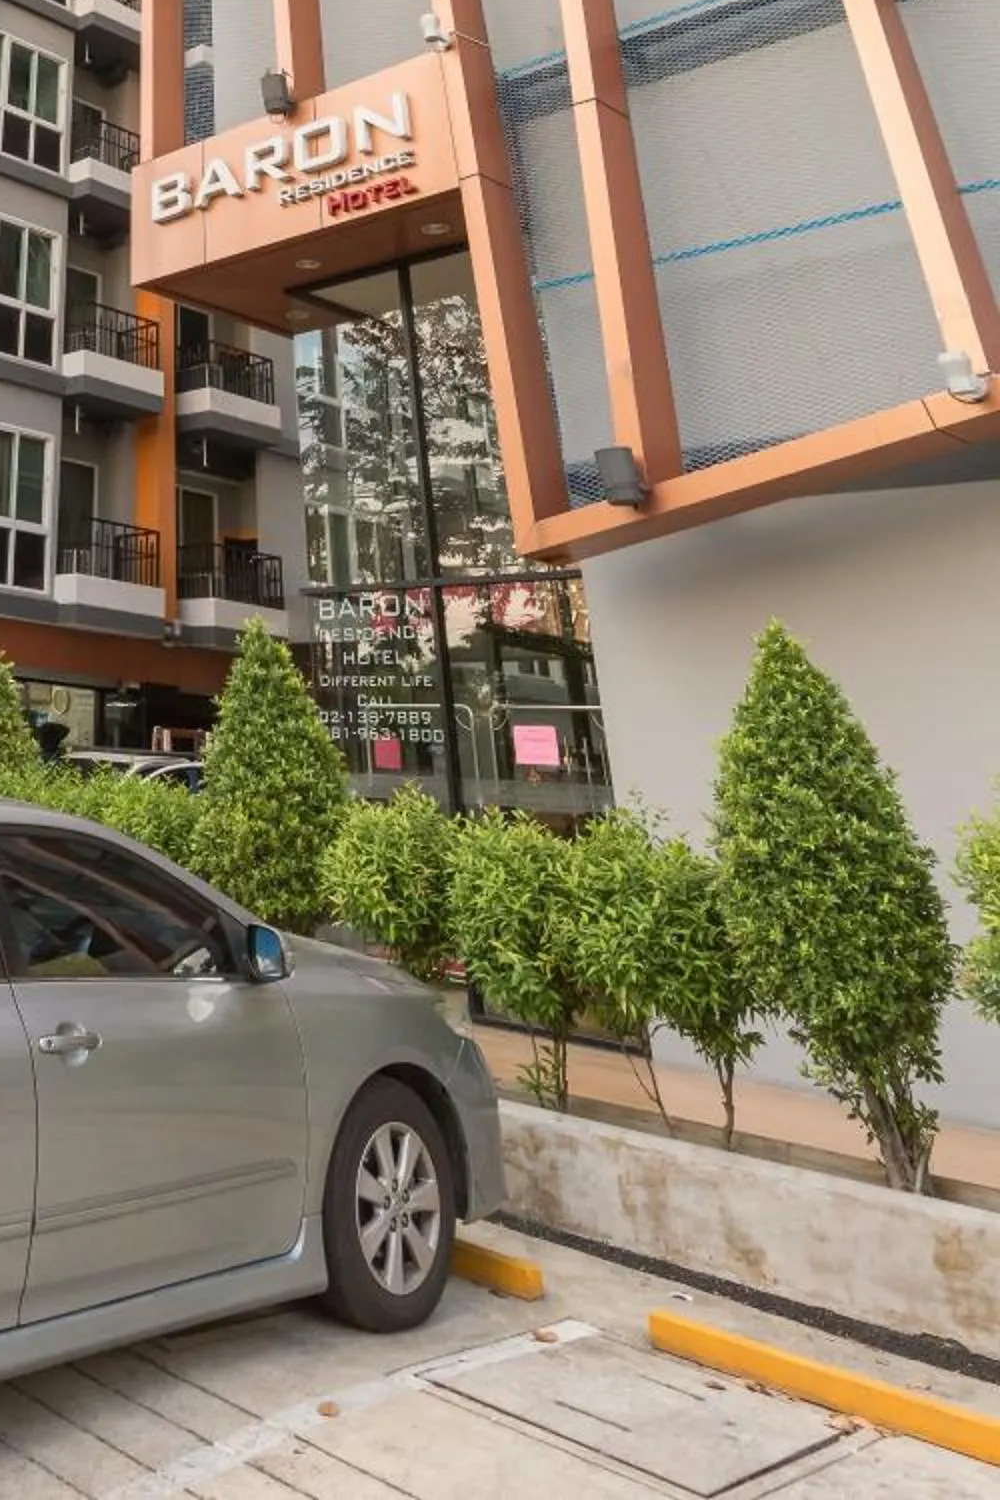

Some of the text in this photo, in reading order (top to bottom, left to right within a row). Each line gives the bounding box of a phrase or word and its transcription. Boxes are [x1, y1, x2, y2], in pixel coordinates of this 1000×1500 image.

[150, 90, 413, 225] BARON
[279, 150, 417, 208] RESIDENCE
[327, 176, 419, 217] HOTEL
[319, 592, 427, 621] BARON
[343, 649, 407, 665] HOTEL
[320, 675, 433, 687] DIFFERENT LIFE
[326, 726, 445, 743] 81-963-1800
